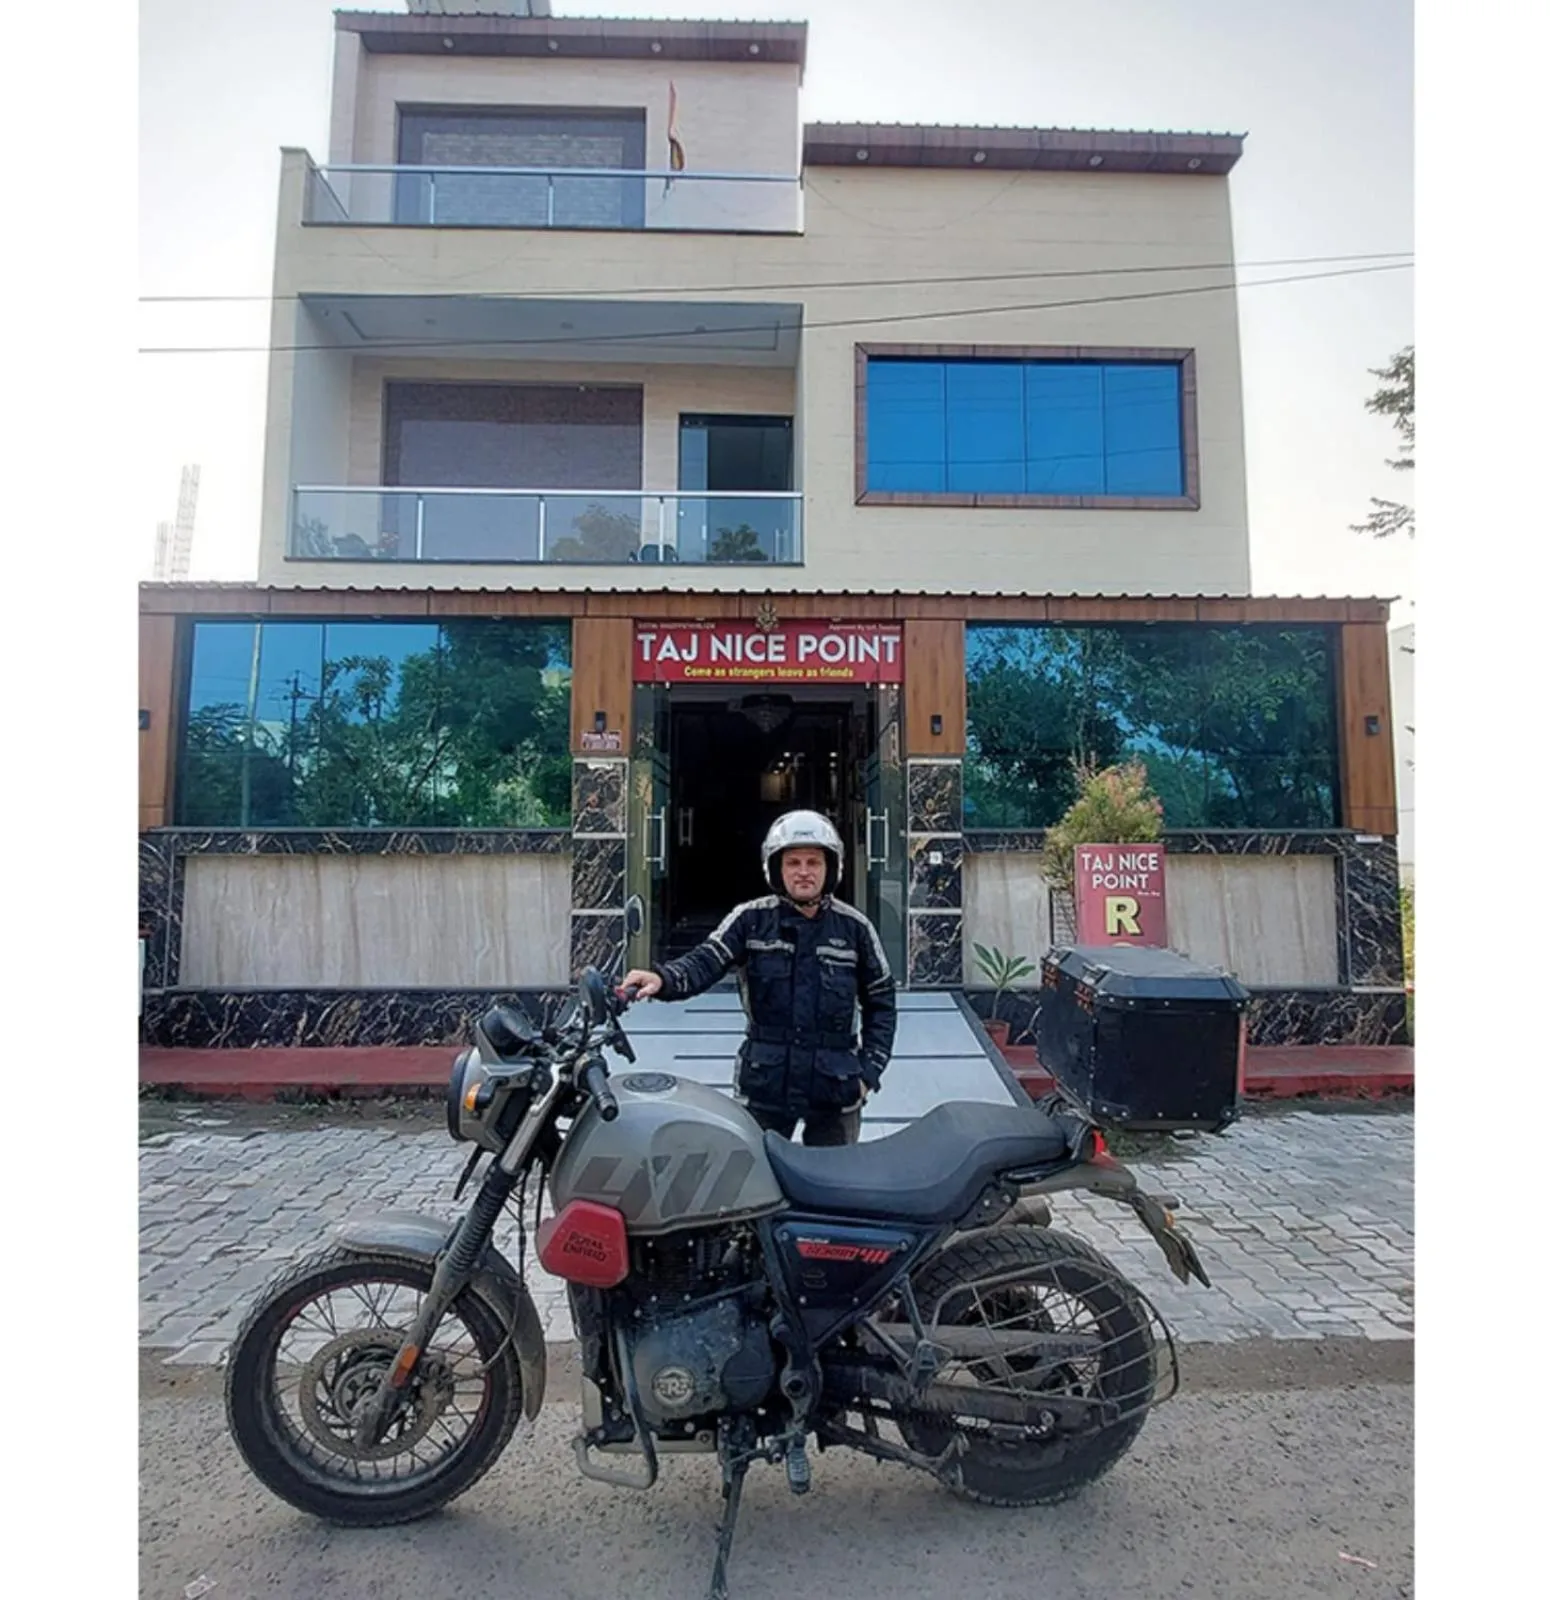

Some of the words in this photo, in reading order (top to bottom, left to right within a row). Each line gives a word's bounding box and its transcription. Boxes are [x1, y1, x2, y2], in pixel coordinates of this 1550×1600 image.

[637, 633, 699, 662] TAJ
[710, 633, 786, 662] NICE
[798, 634, 900, 663] POINT
[684, 666, 712, 677] Come
[714, 668, 726, 677] as
[729, 667, 775, 679] strangers
[777, 667, 804, 677] leave
[820, 667, 854, 677] friends
[1081, 853, 1114, 871] TAJ
[1119, 853, 1159, 871] NICE
[1092, 874, 1148, 889] POINT
